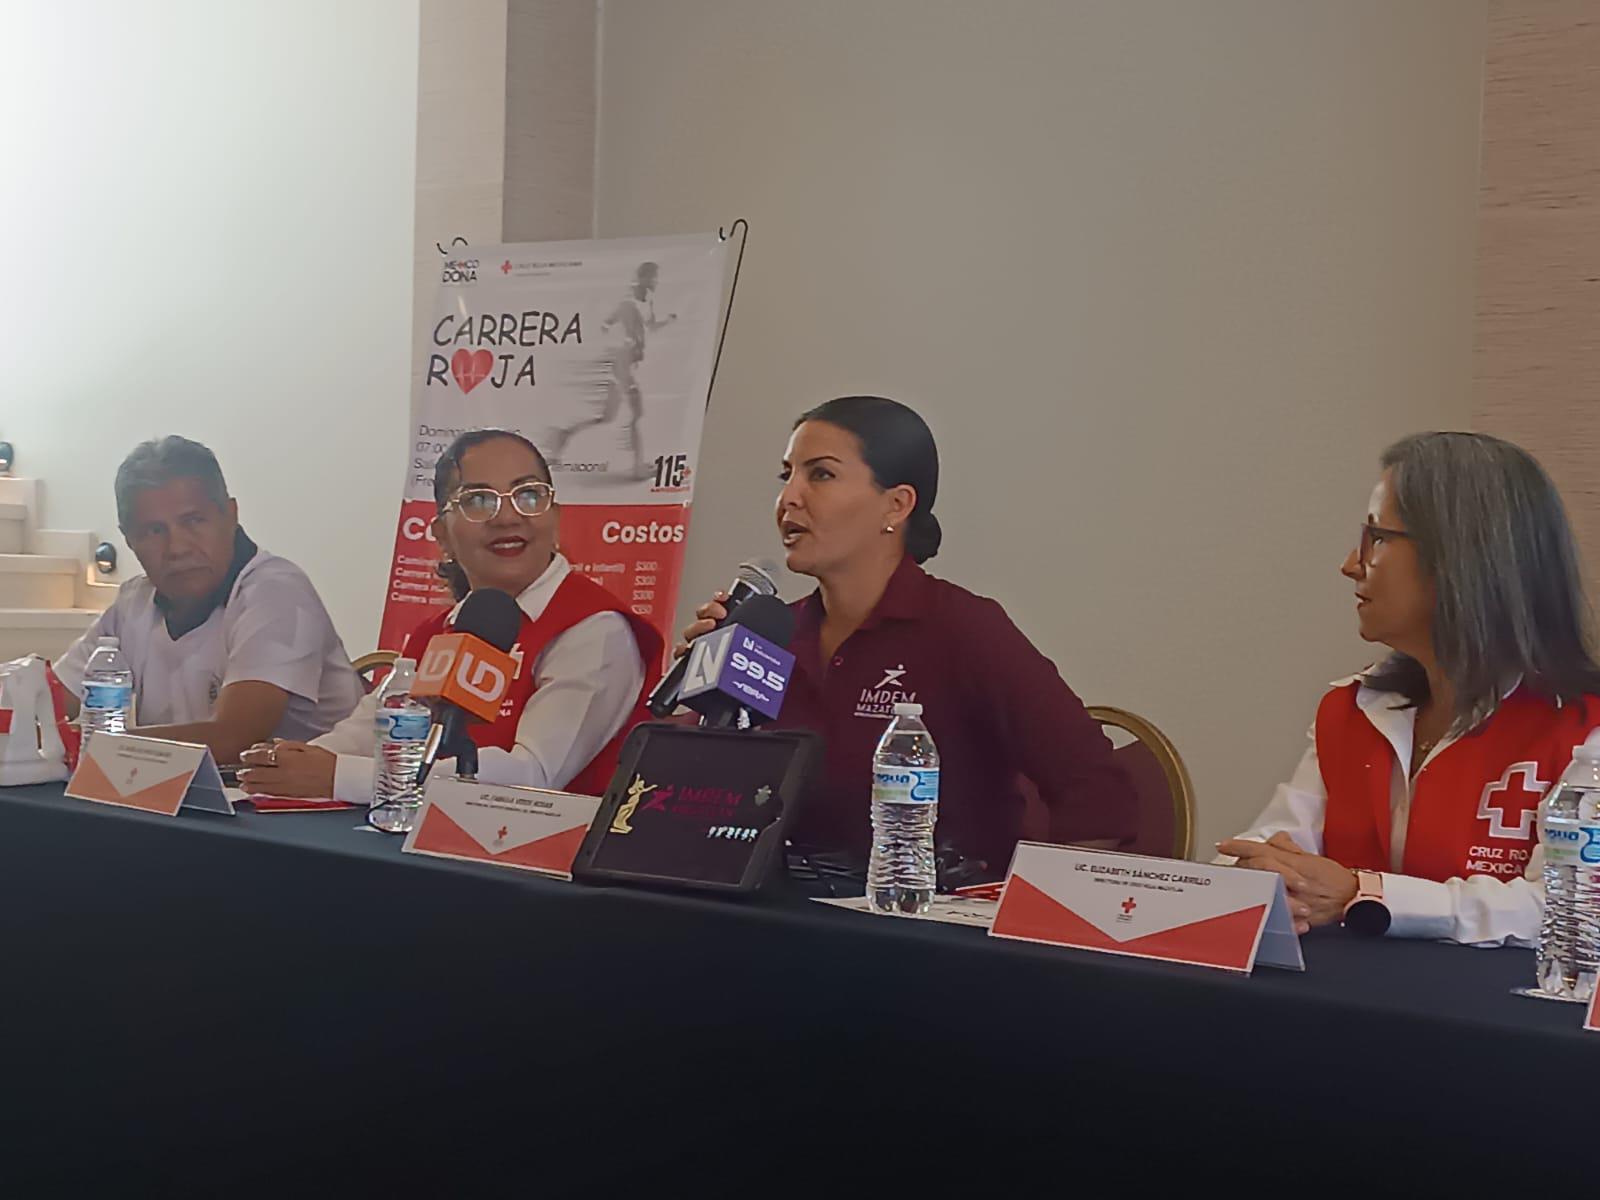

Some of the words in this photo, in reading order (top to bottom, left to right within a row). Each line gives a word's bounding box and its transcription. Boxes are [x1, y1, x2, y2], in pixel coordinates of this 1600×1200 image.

[442, 270, 478, 283] DONA
[433, 311, 583, 347] CARRERA
[654, 454, 687, 488] 115
[602, 520, 685, 544] Costos
[730, 652, 786, 692] 99.5
[856, 703, 896, 715] MAZAT
[1469, 846, 1504, 859] CRUZ
[1509, 849, 1530, 861] RO
[1465, 859, 1524, 874] MEXICA
